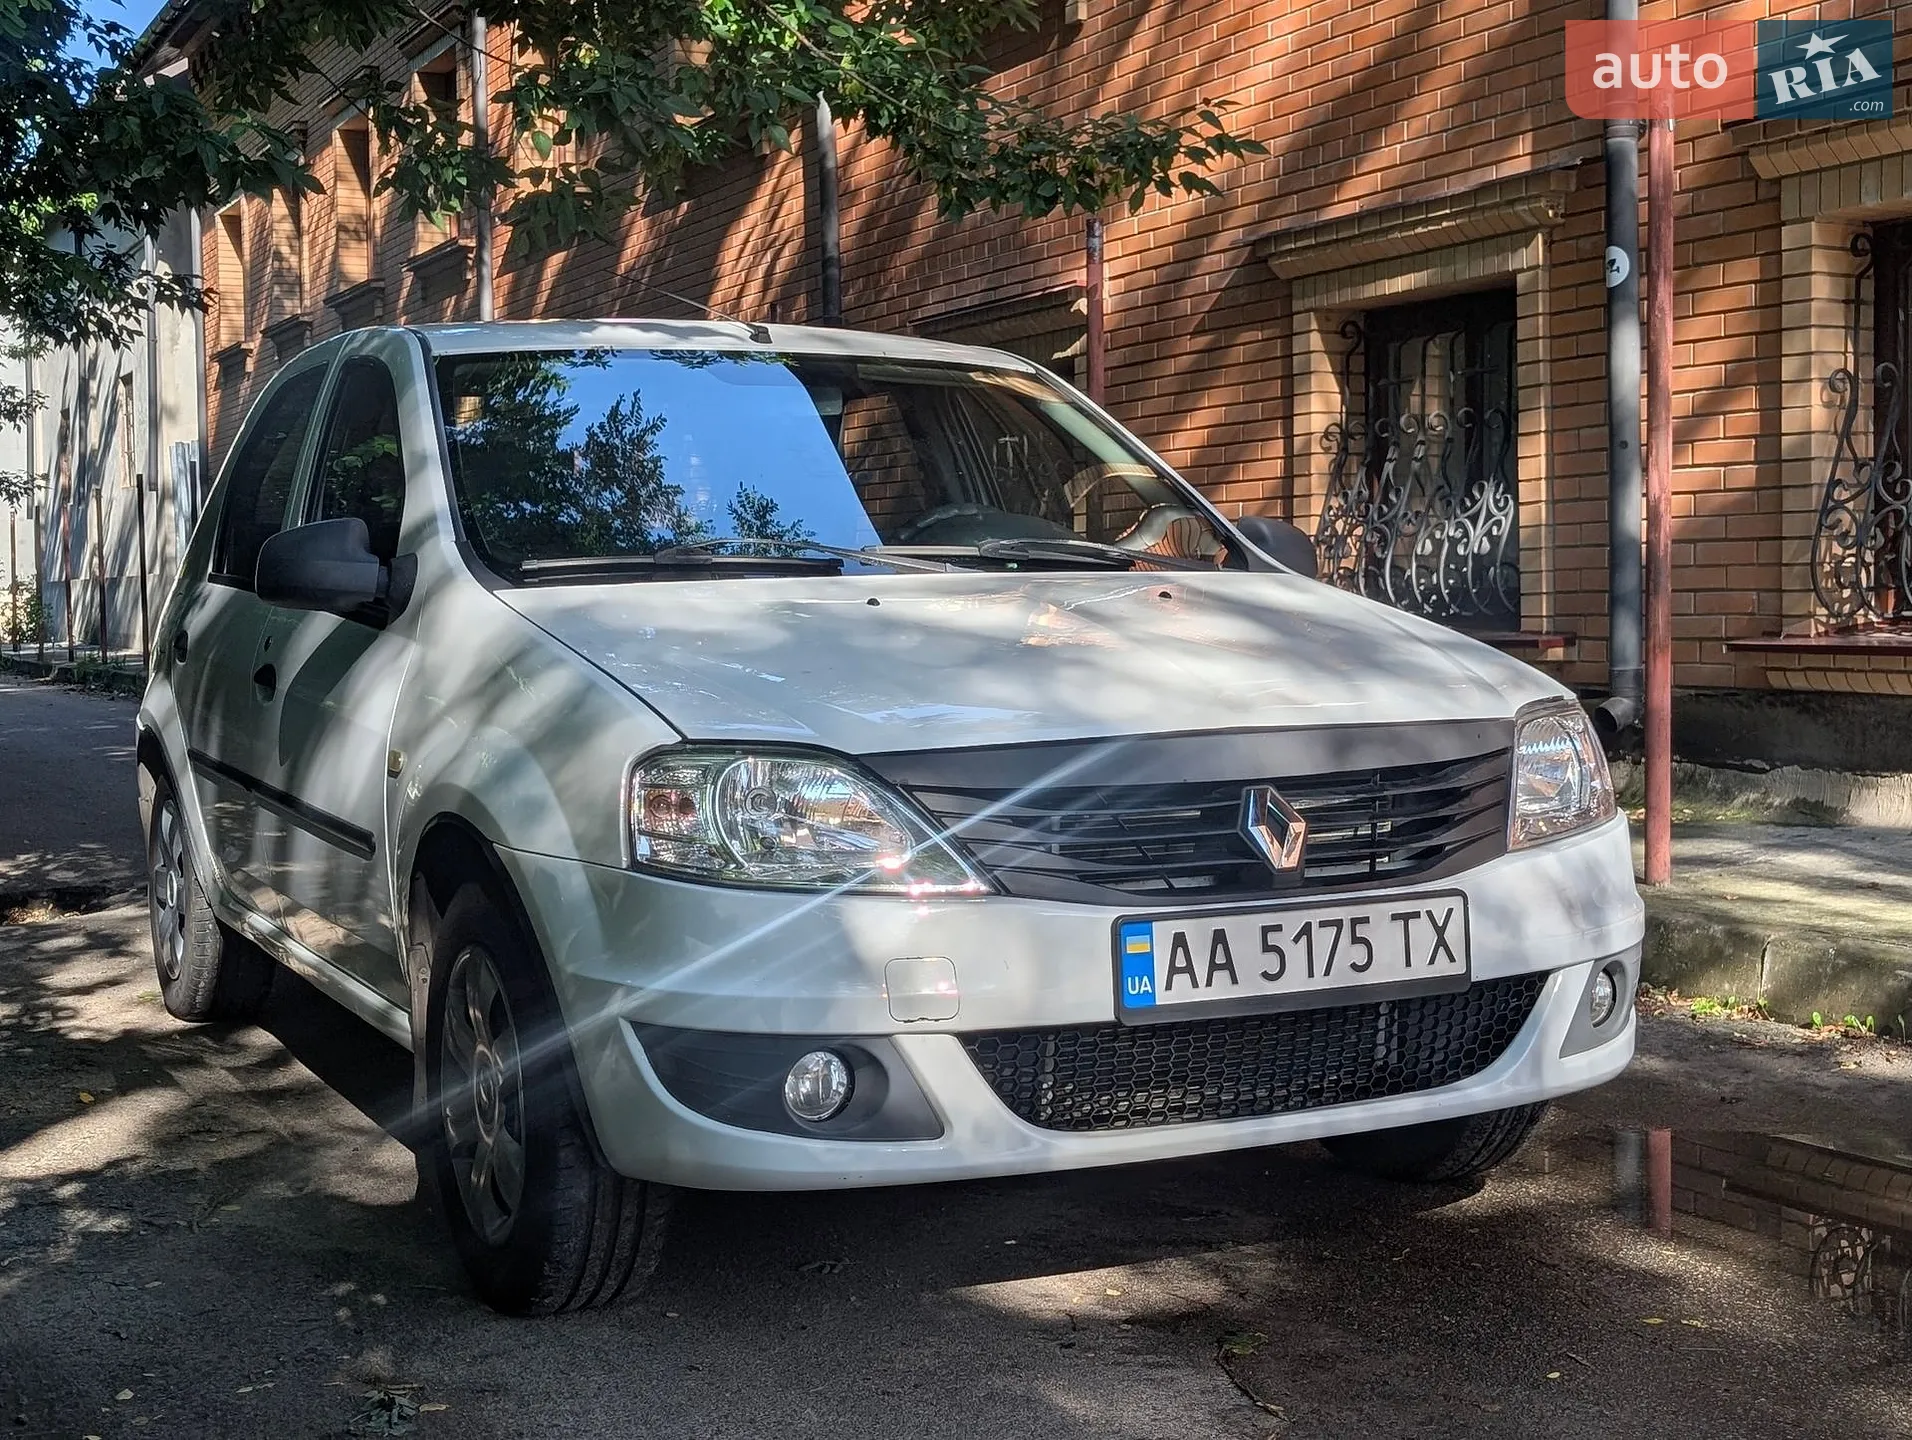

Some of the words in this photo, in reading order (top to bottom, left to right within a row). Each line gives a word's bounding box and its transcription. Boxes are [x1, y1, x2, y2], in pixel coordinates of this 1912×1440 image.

[1164, 928, 1239, 992] AA
[1259, 916, 1374, 982] 5175
[1390, 907, 1457, 968] TX
[1127, 976, 1152, 995] UA
